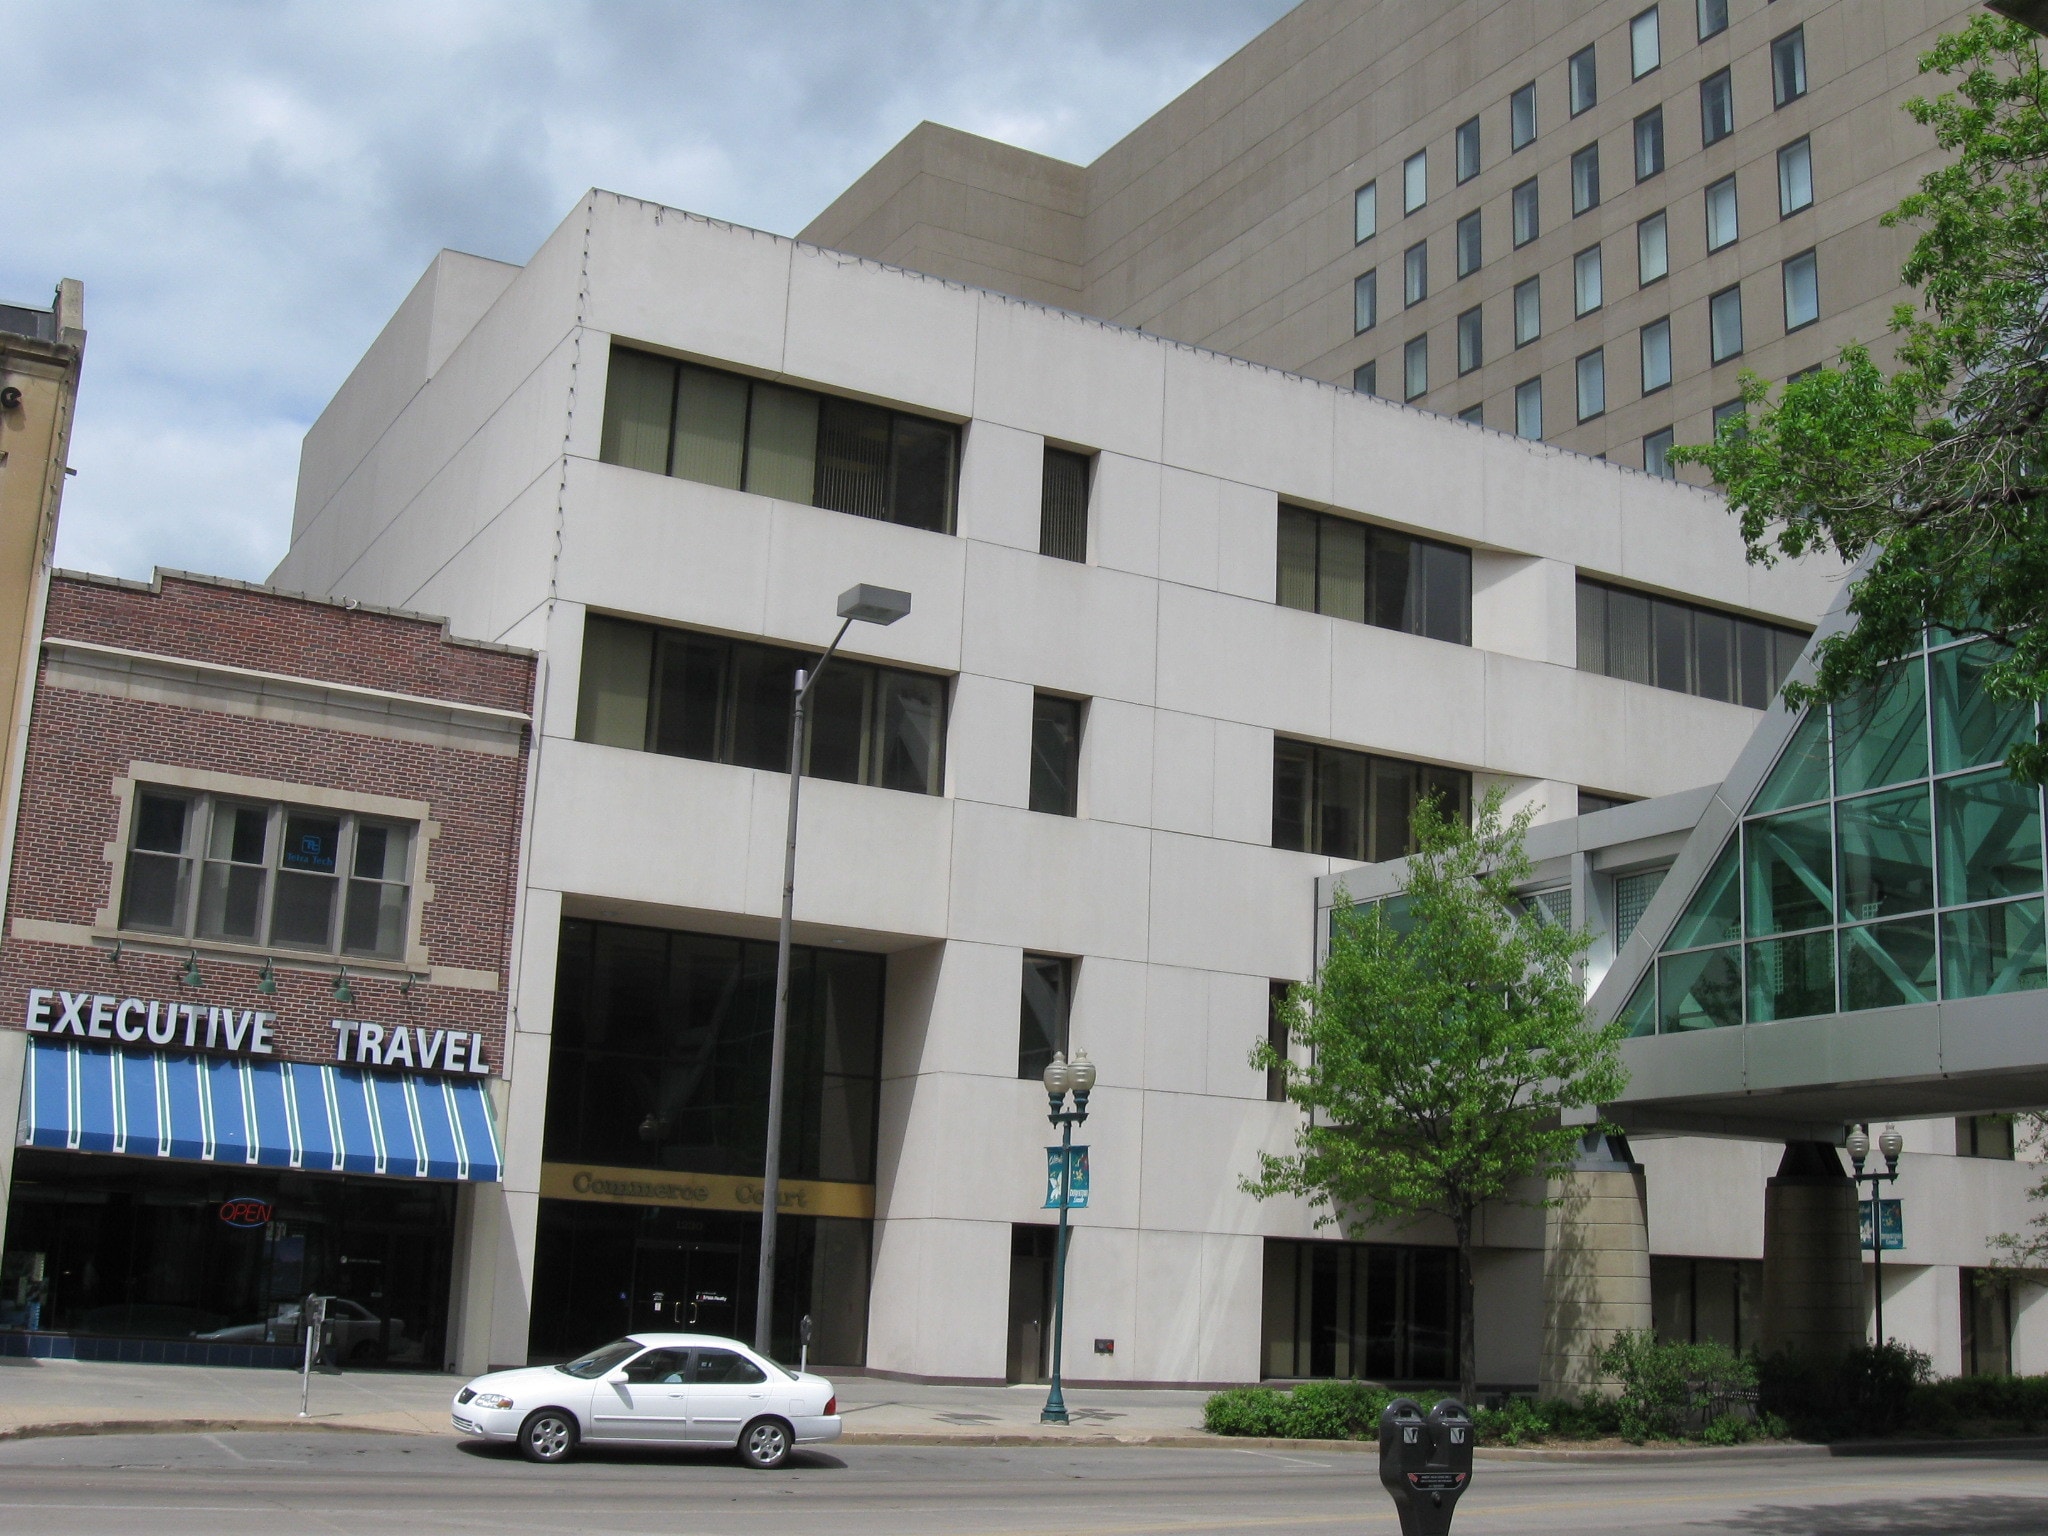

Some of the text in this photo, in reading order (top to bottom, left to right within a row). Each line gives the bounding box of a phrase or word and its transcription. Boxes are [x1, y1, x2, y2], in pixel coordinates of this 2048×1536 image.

[26, 988, 489, 1074] EXECUTIVE TRAVEL
[573, 1172, 709, 1202] Commerce
[219, 1202, 272, 1222] OPEN
